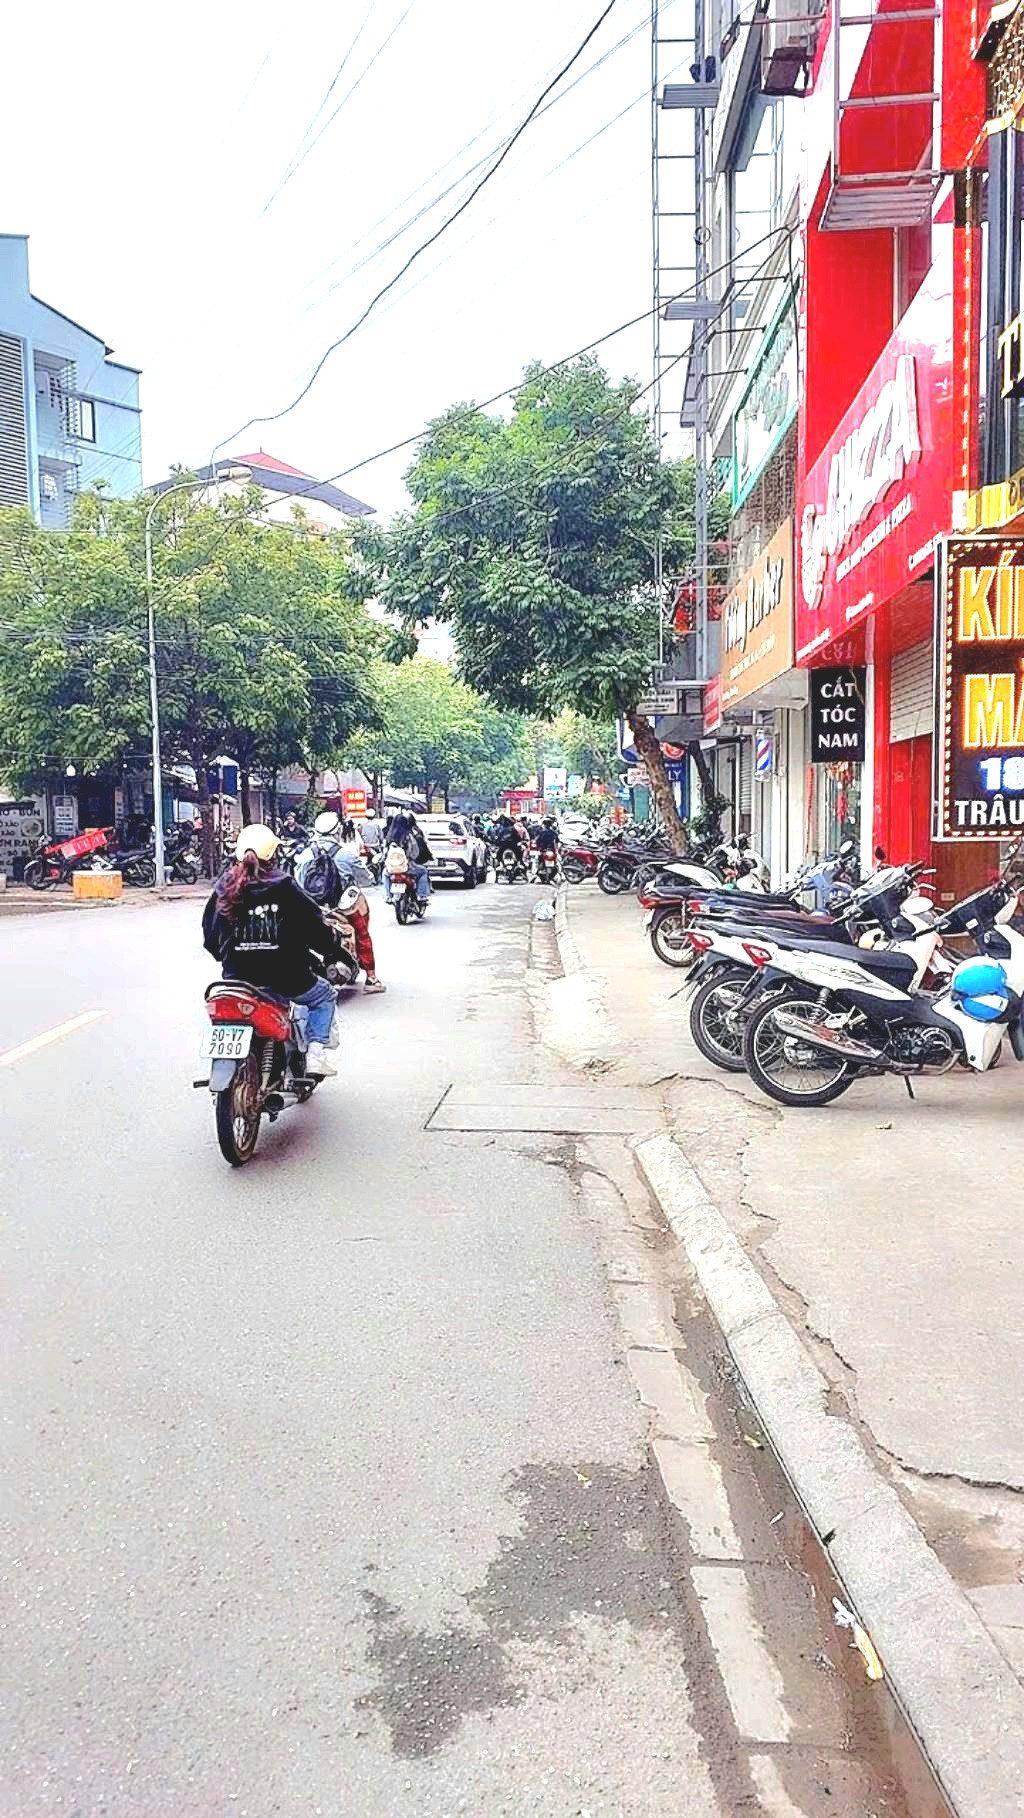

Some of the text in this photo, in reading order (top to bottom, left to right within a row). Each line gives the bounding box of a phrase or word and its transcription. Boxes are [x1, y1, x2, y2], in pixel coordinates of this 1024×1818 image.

[820, 704, 857, 723] TÓC
[818, 732, 859, 749] NAM
[955, 793, 1024, 827] TRÂU
[208, 1042, 242, 1056] 7090
